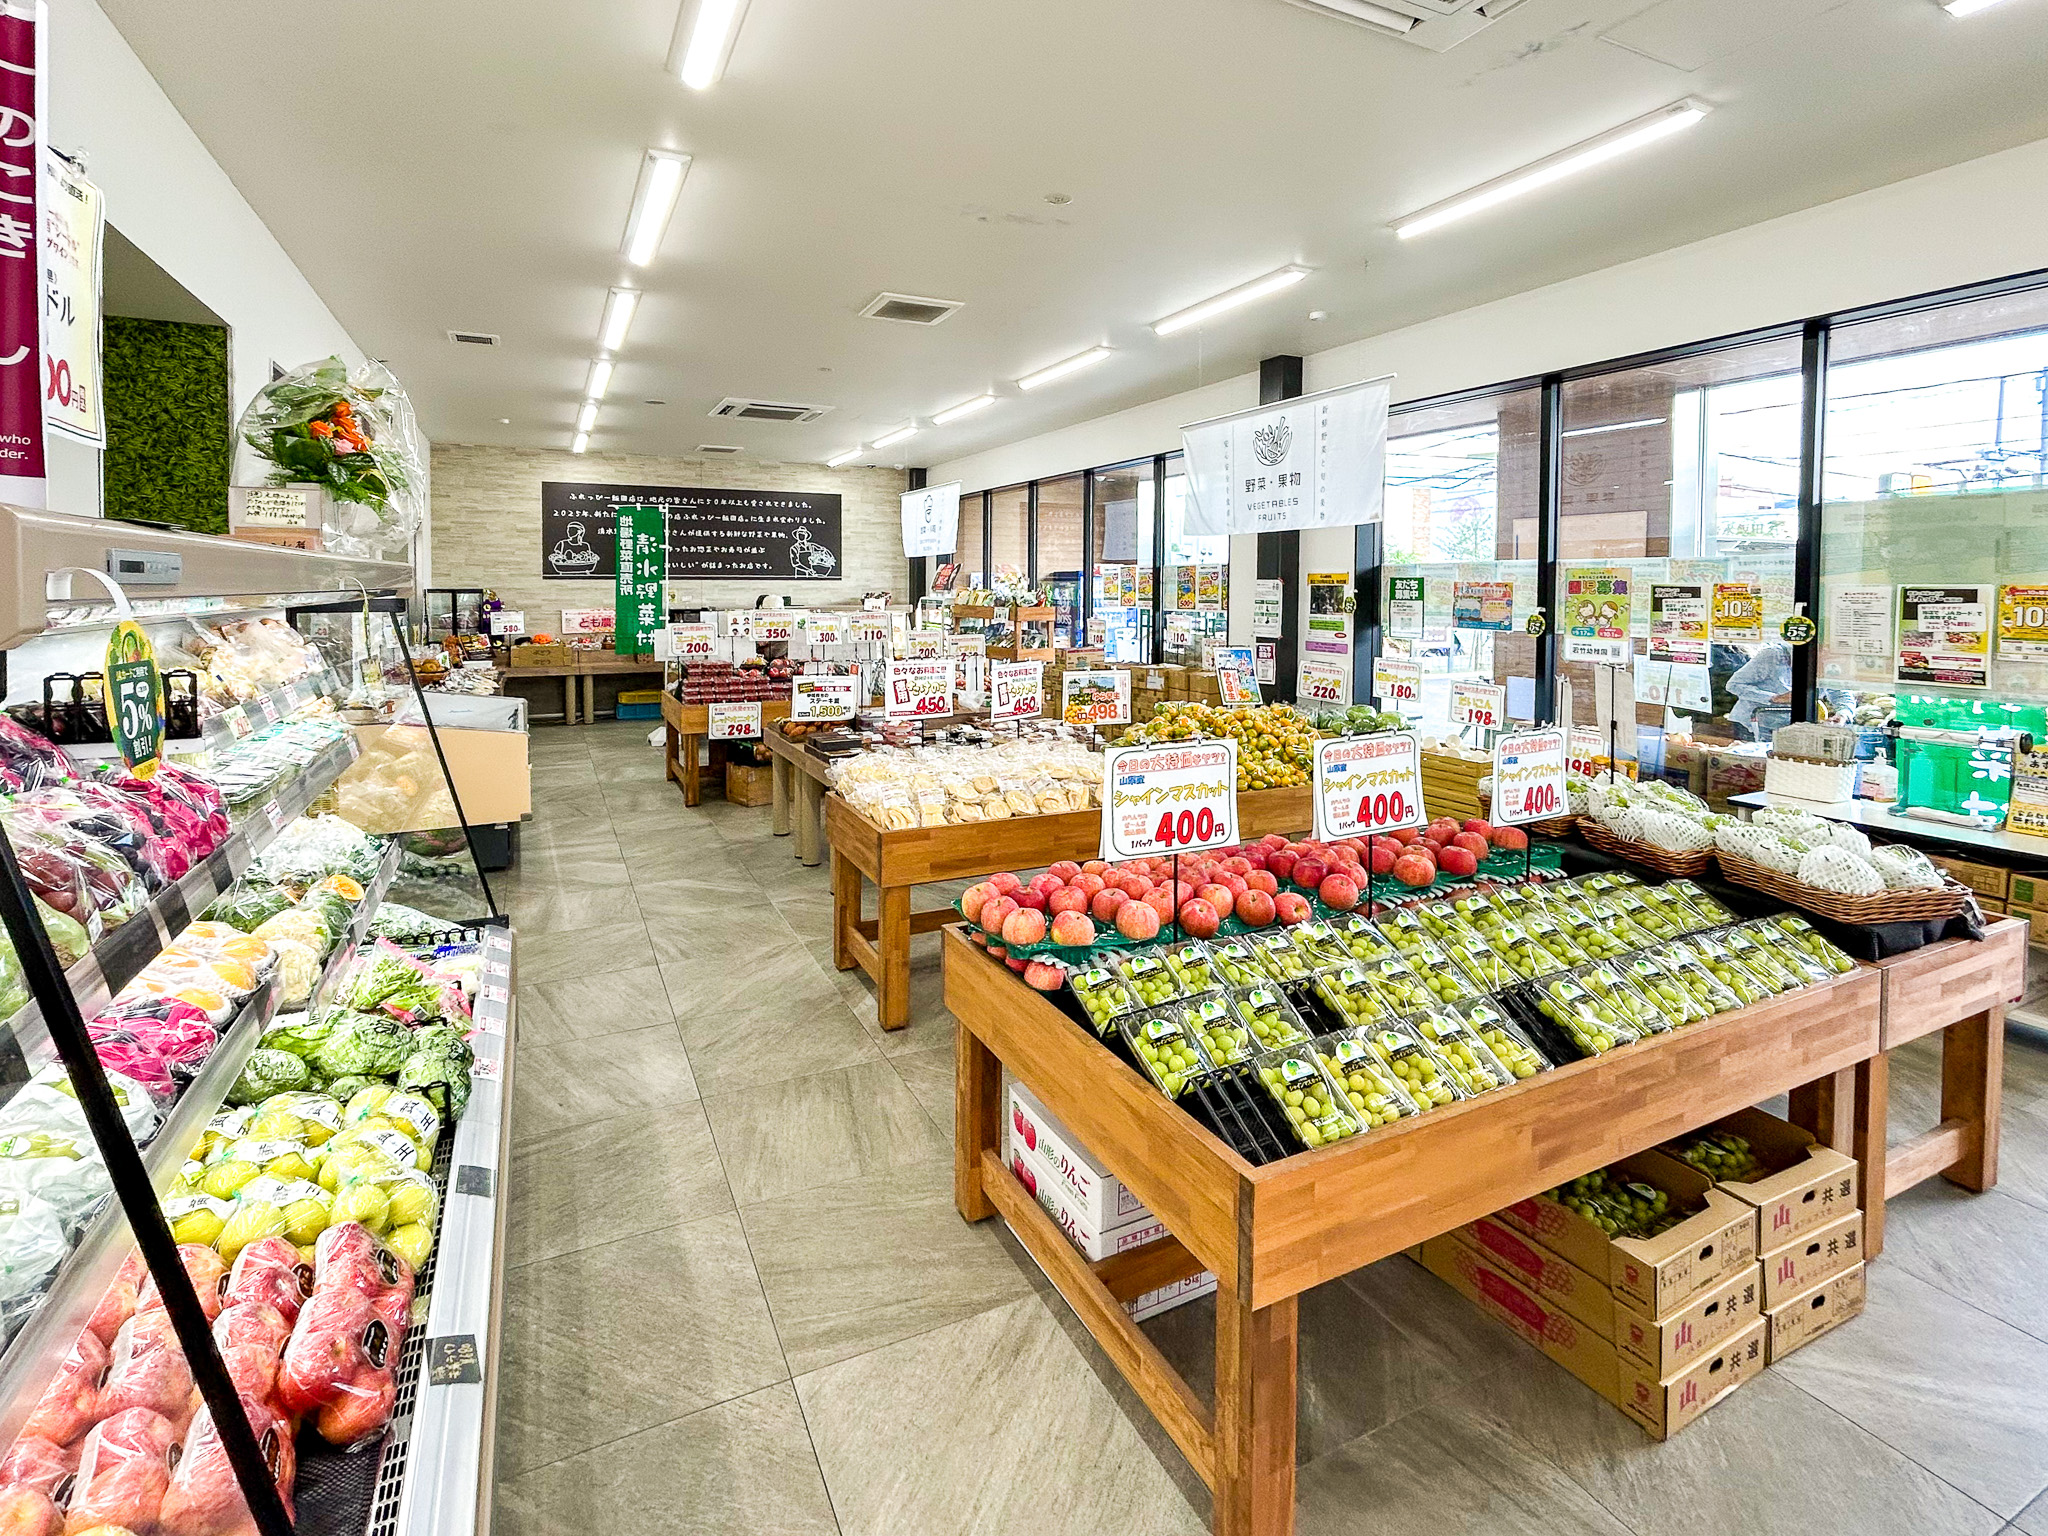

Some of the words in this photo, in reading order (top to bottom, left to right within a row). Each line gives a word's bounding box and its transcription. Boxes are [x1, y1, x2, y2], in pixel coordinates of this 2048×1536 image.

[1245, 473, 1301, 493] 野菜・果物
[1247, 497, 1299, 511] VEGETABLES
[1258, 512, 1287, 521] FRUITS
[1395, 580, 1418, 590] 友だち
[1395, 590, 1418, 600] 募集中
[1568, 580, 1627, 595] 園児募集
[1458, 696, 1492, 709] だいこん
[1323, 767, 1415, 793] シャインマスカット
[1499, 762, 1562, 783] シャインマスカット
[1114, 780, 1228, 808] シャインマスカット
[1524, 783, 1561, 815] 400円
[1357, 791, 1414, 828] 400円
[1155, 807, 1225, 848] 400円
[1038, 1138, 1091, 1198] 山形のりんご
[1038, 1188, 1091, 1252] 山形のりんご
